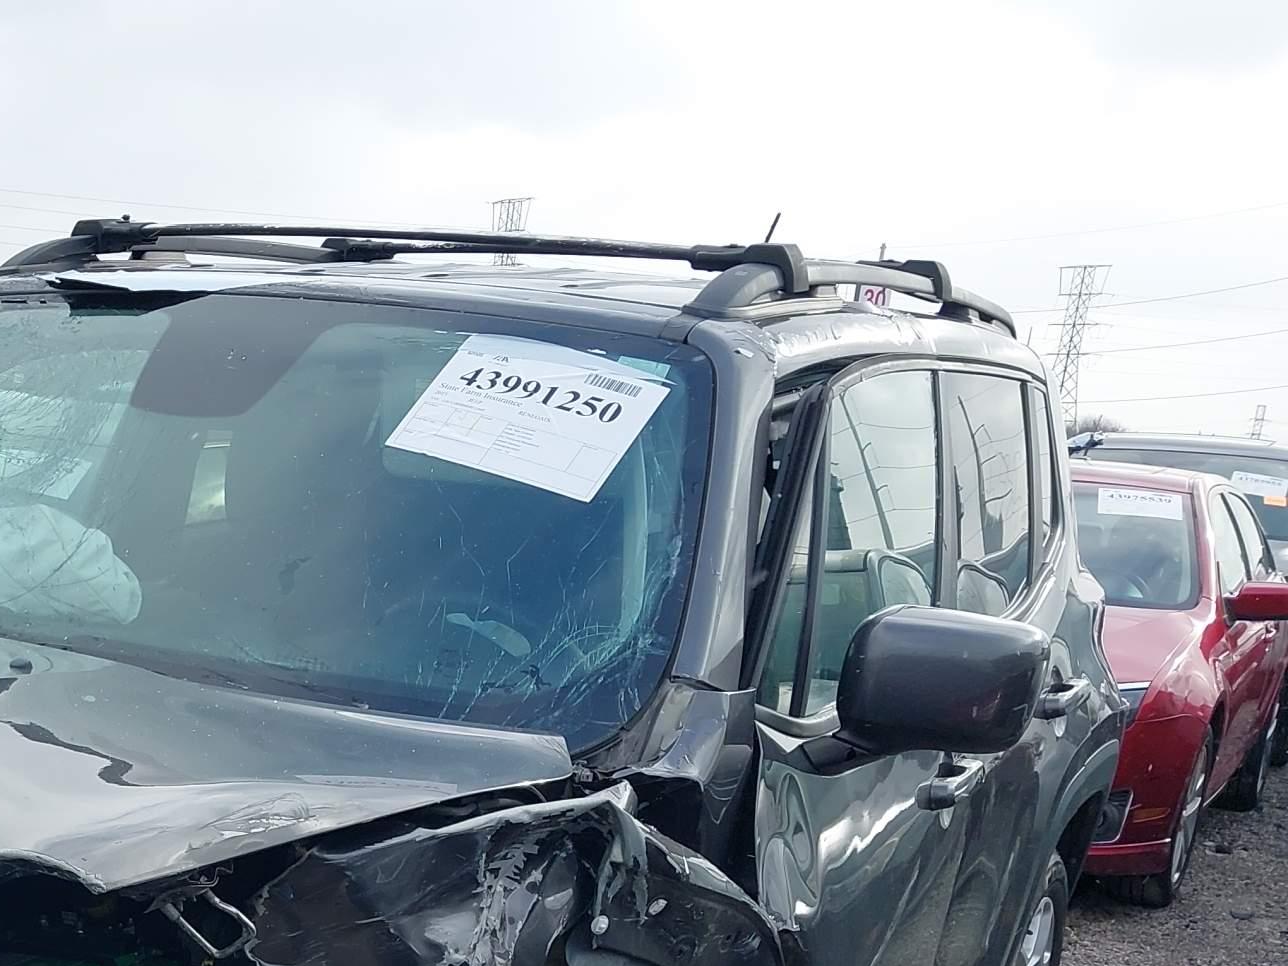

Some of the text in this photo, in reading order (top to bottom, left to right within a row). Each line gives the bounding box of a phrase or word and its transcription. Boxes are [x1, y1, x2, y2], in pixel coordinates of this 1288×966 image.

[440, 382, 459, 392] State
[460, 386, 483, 398] Farm
[483, 391, 524, 407] Insurance
[459, 367, 623, 424] 43991250
